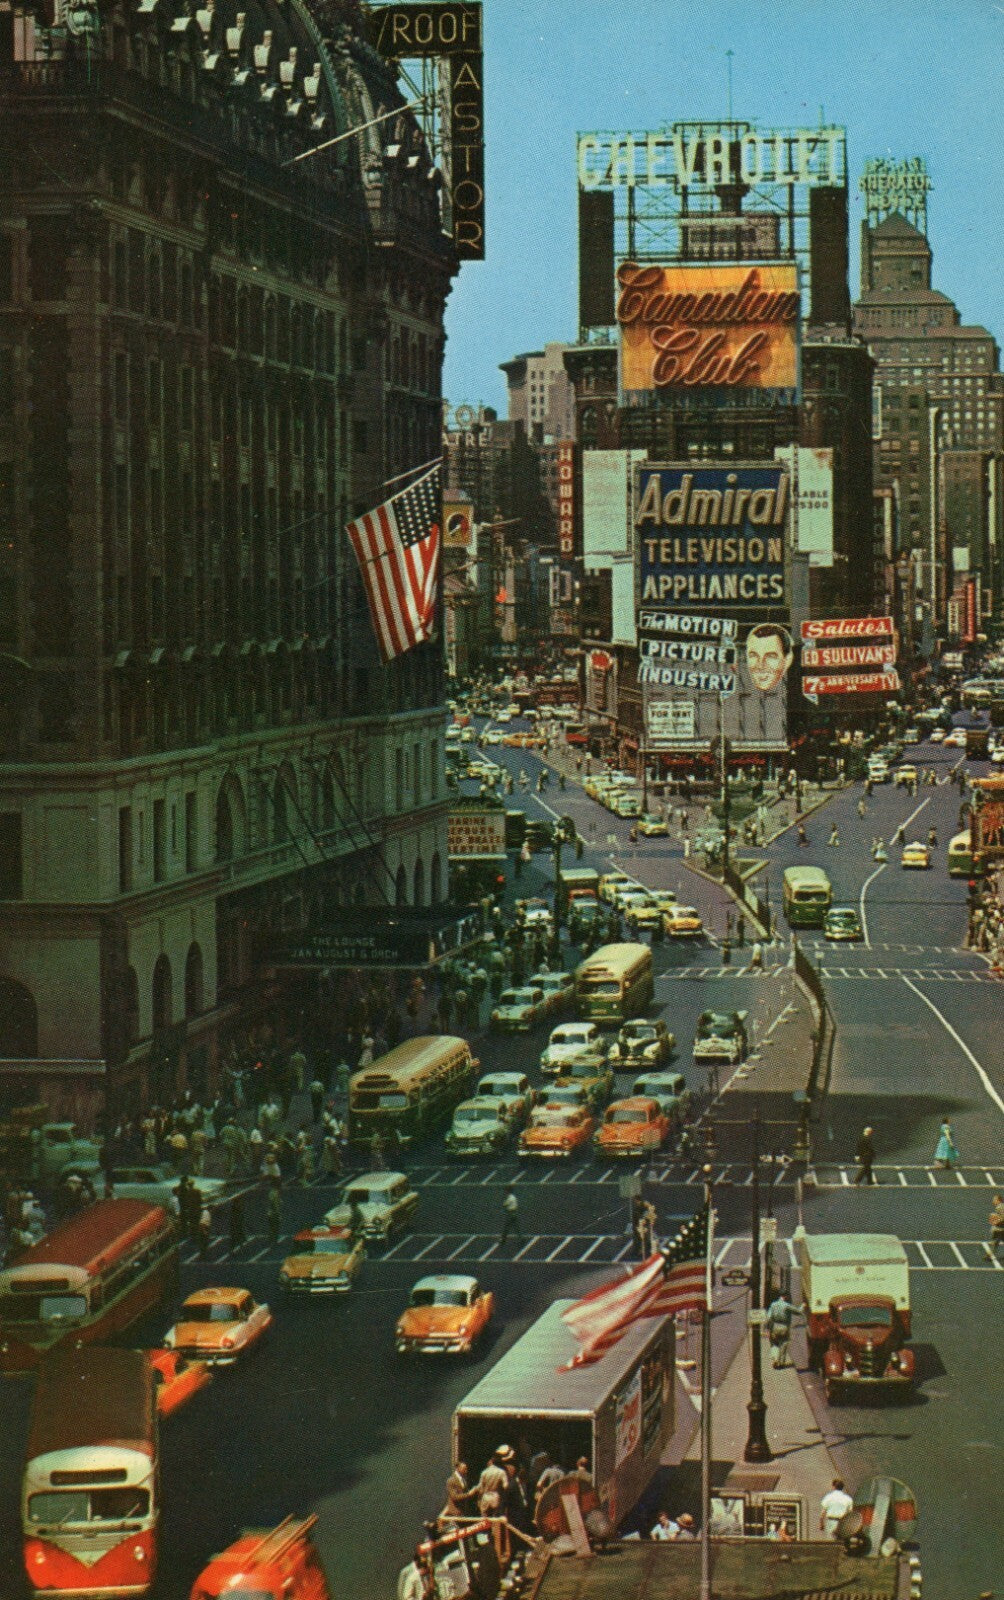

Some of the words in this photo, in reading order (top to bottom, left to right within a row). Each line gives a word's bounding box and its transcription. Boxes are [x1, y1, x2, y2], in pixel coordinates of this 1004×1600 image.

[392, 12, 477, 44] ROOF
[453, 62, 484, 250] ASTOR
[578, 130, 845, 187] CHEVROLET
[616, 262, 801, 322] Canadian
[651, 326, 761, 385] Club
[560, 448, 573, 553] HOWARD
[634, 473, 790, 525] Admiral
[644, 537, 783, 564] TELEVISION
[642, 573, 784, 600] APPLIANCES
[665, 613, 733, 636] MOTION
[806, 621, 889, 638] Salutes
[648, 640, 728, 664] PICTURE
[804, 648, 819, 666] ED
[642, 667, 733, 690] INDUSTRY
